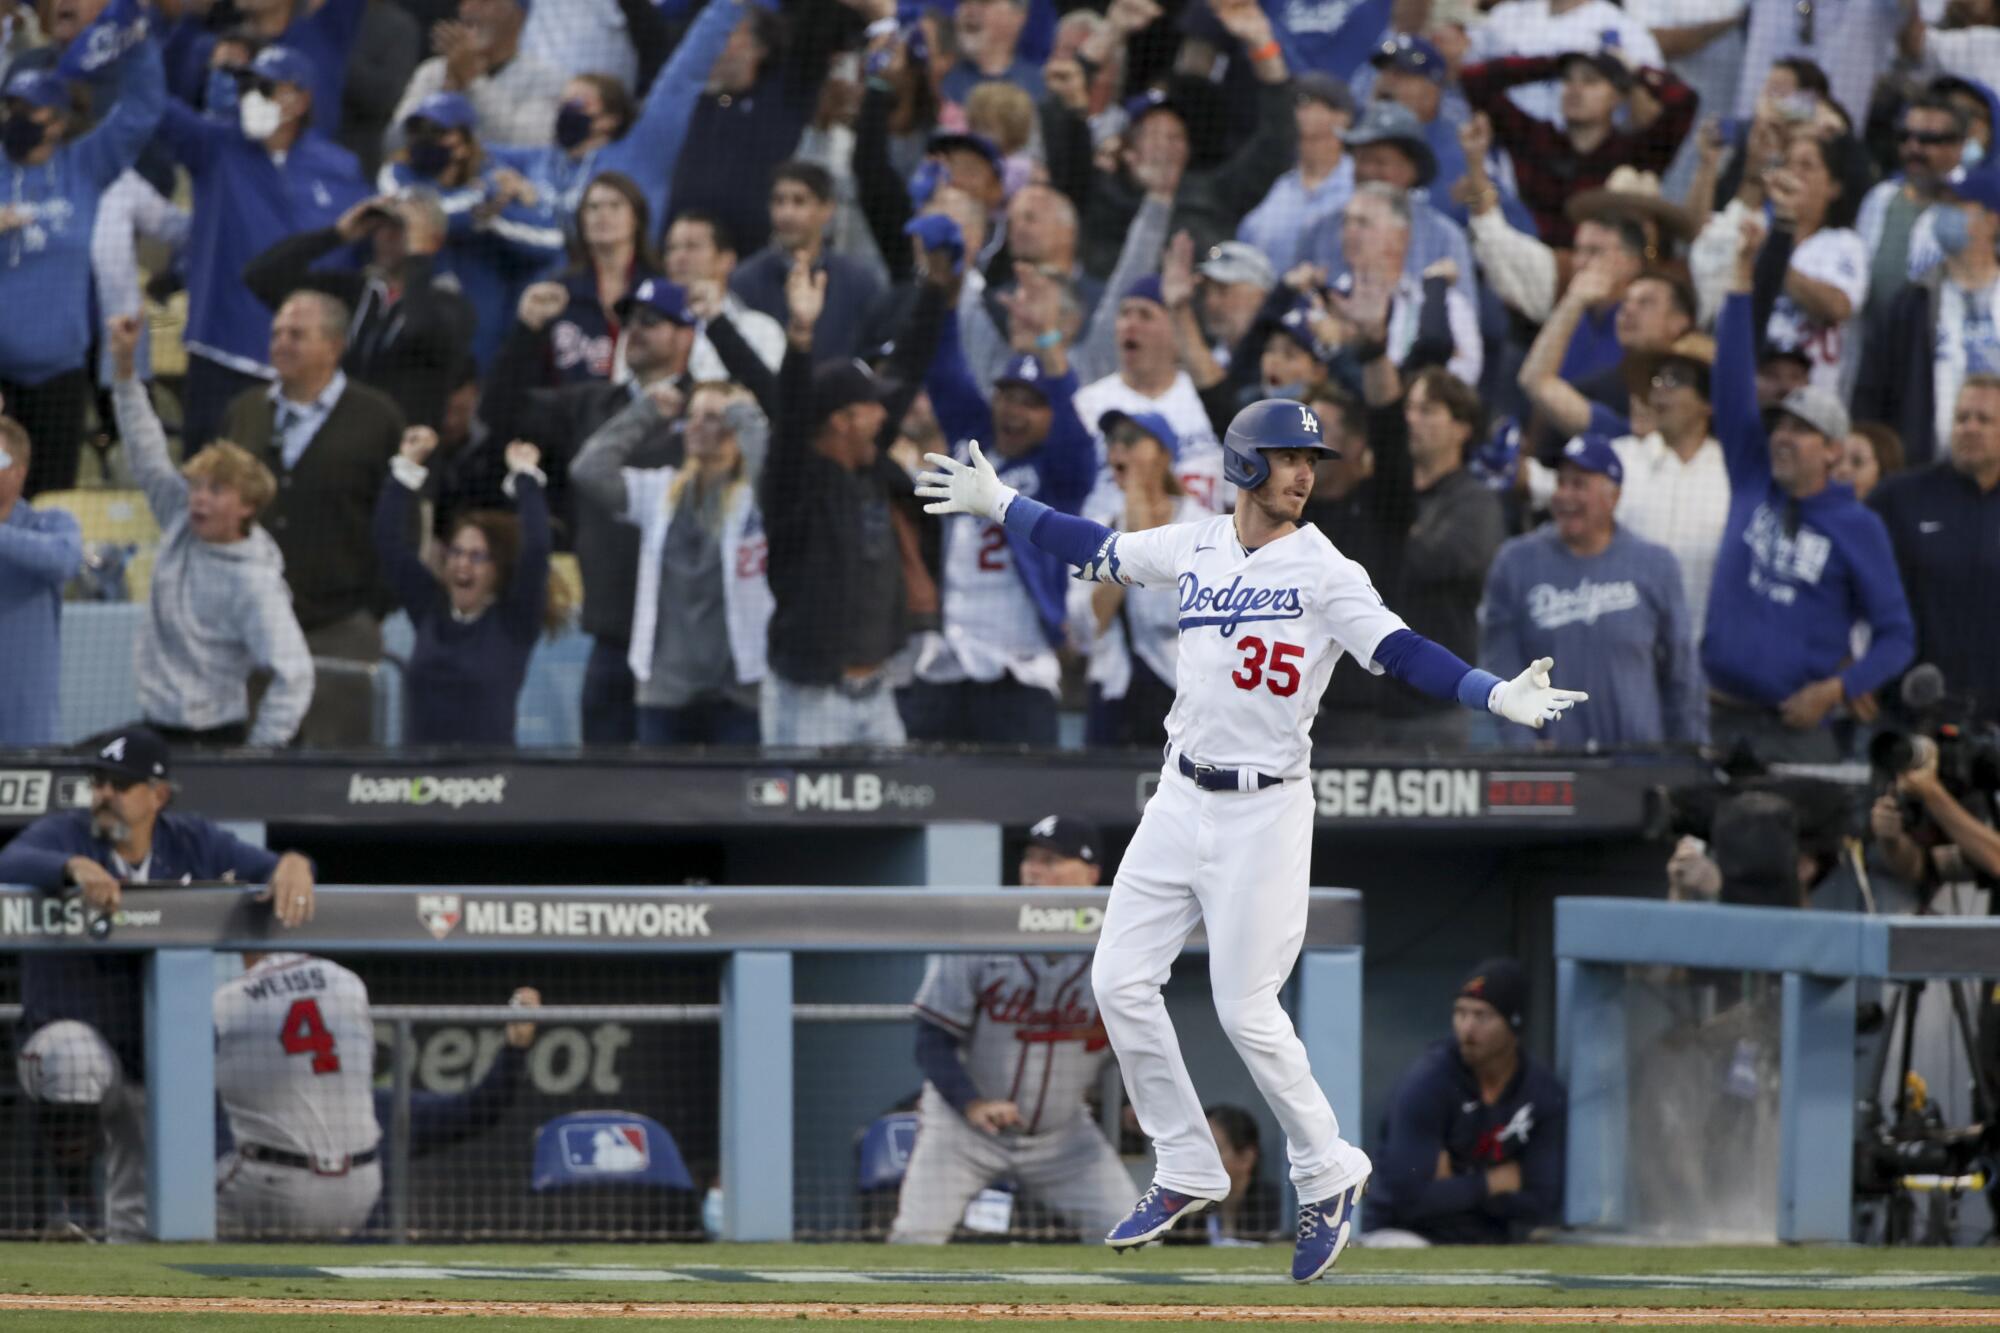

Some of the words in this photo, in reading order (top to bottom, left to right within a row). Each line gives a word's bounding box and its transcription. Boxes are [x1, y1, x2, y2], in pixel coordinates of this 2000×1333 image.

[1299, 406, 1319, 434] LA
[1178, 571, 1304, 638] Dodgers
[1527, 576, 1640, 630] Dodgers
[1231, 635, 1306, 698] 35
[349, 772, 507, 810] loanDepot
[796, 772, 883, 812] MLB
[884, 780, 935, 810] App
[2, 897, 85, 935] NLCS
[465, 901, 537, 935] MLB
[541, 903, 712, 936] NETWORK
[1018, 903, 1105, 934] loanD
[243, 967, 326, 1000] WEISS
[279, 997, 342, 1076] 4
